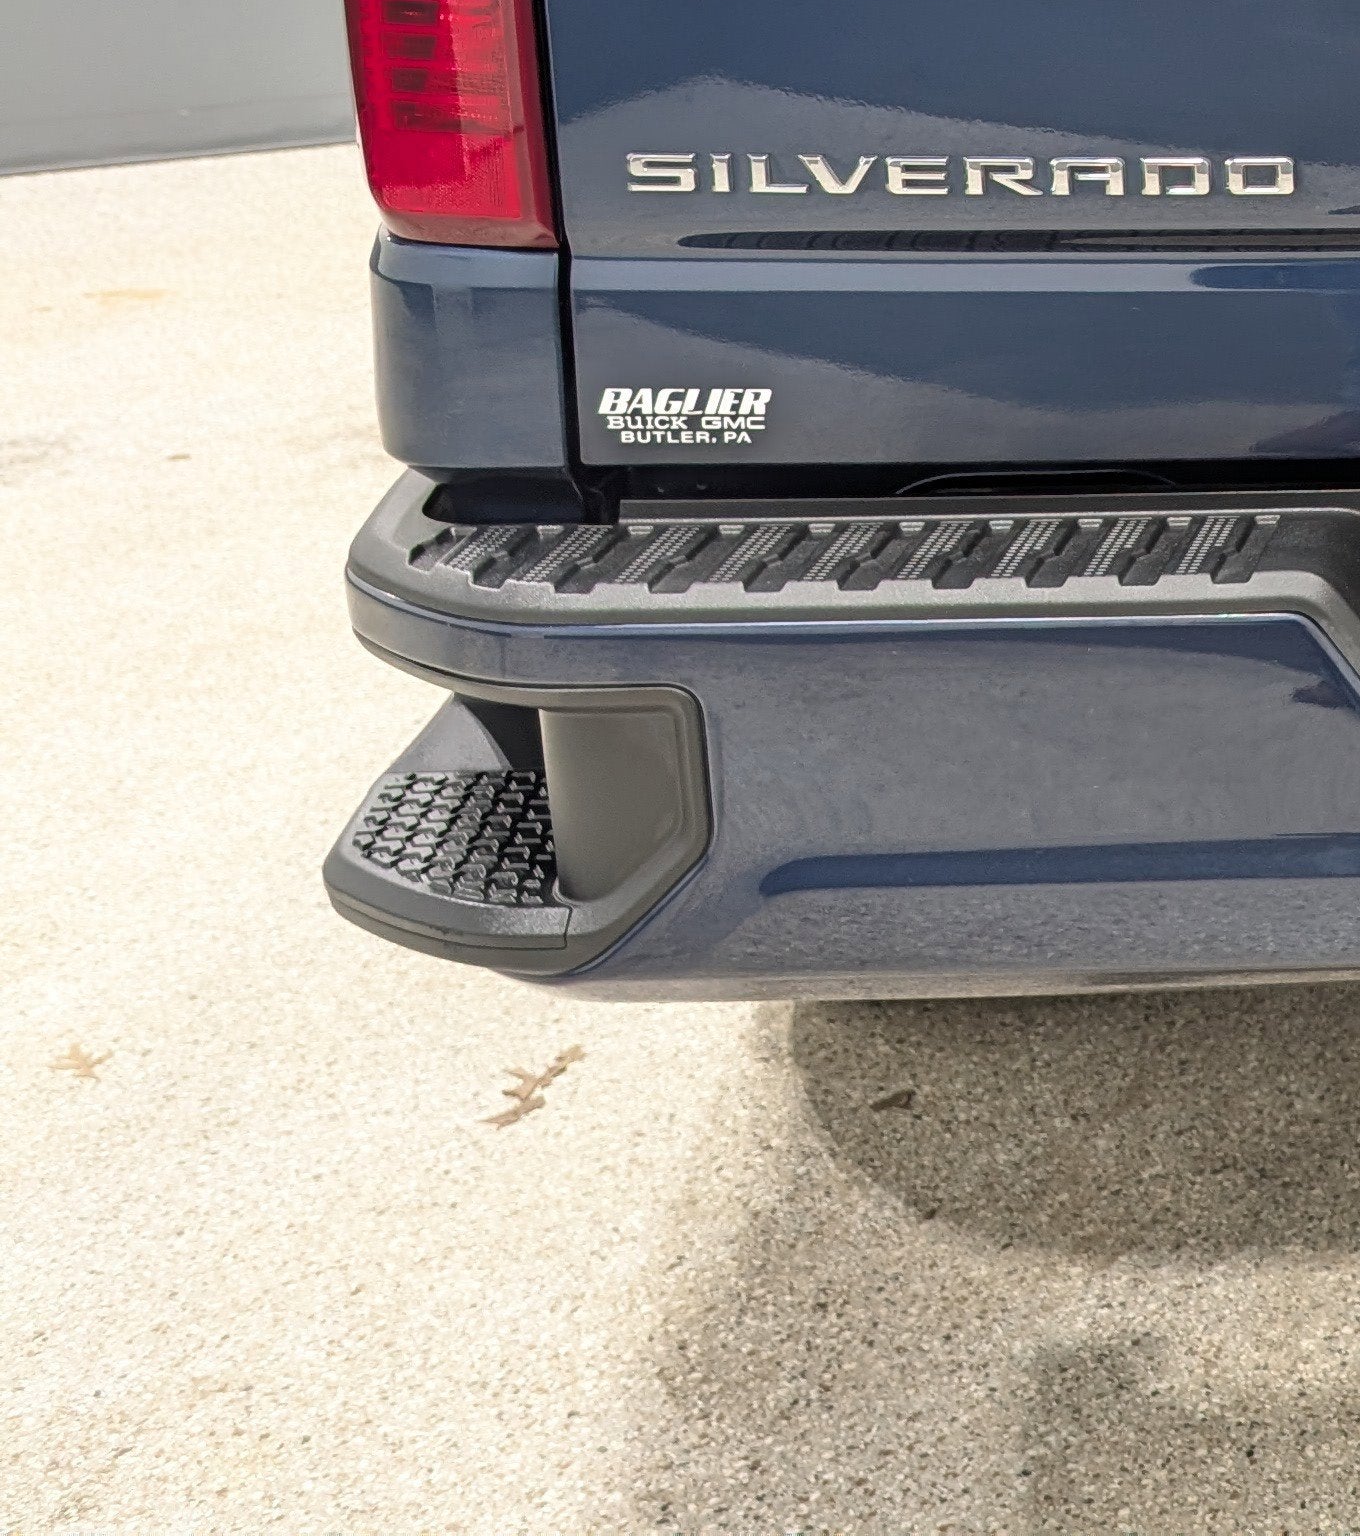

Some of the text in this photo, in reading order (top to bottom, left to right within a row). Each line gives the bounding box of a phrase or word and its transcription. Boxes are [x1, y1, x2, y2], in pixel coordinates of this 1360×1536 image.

[626, 153, 1295, 196] SILVERADO
[598, 388, 772, 415] BAGLIER
[607, 416, 766, 430] BUICK GMC
[724, 432, 752, 444] PA
